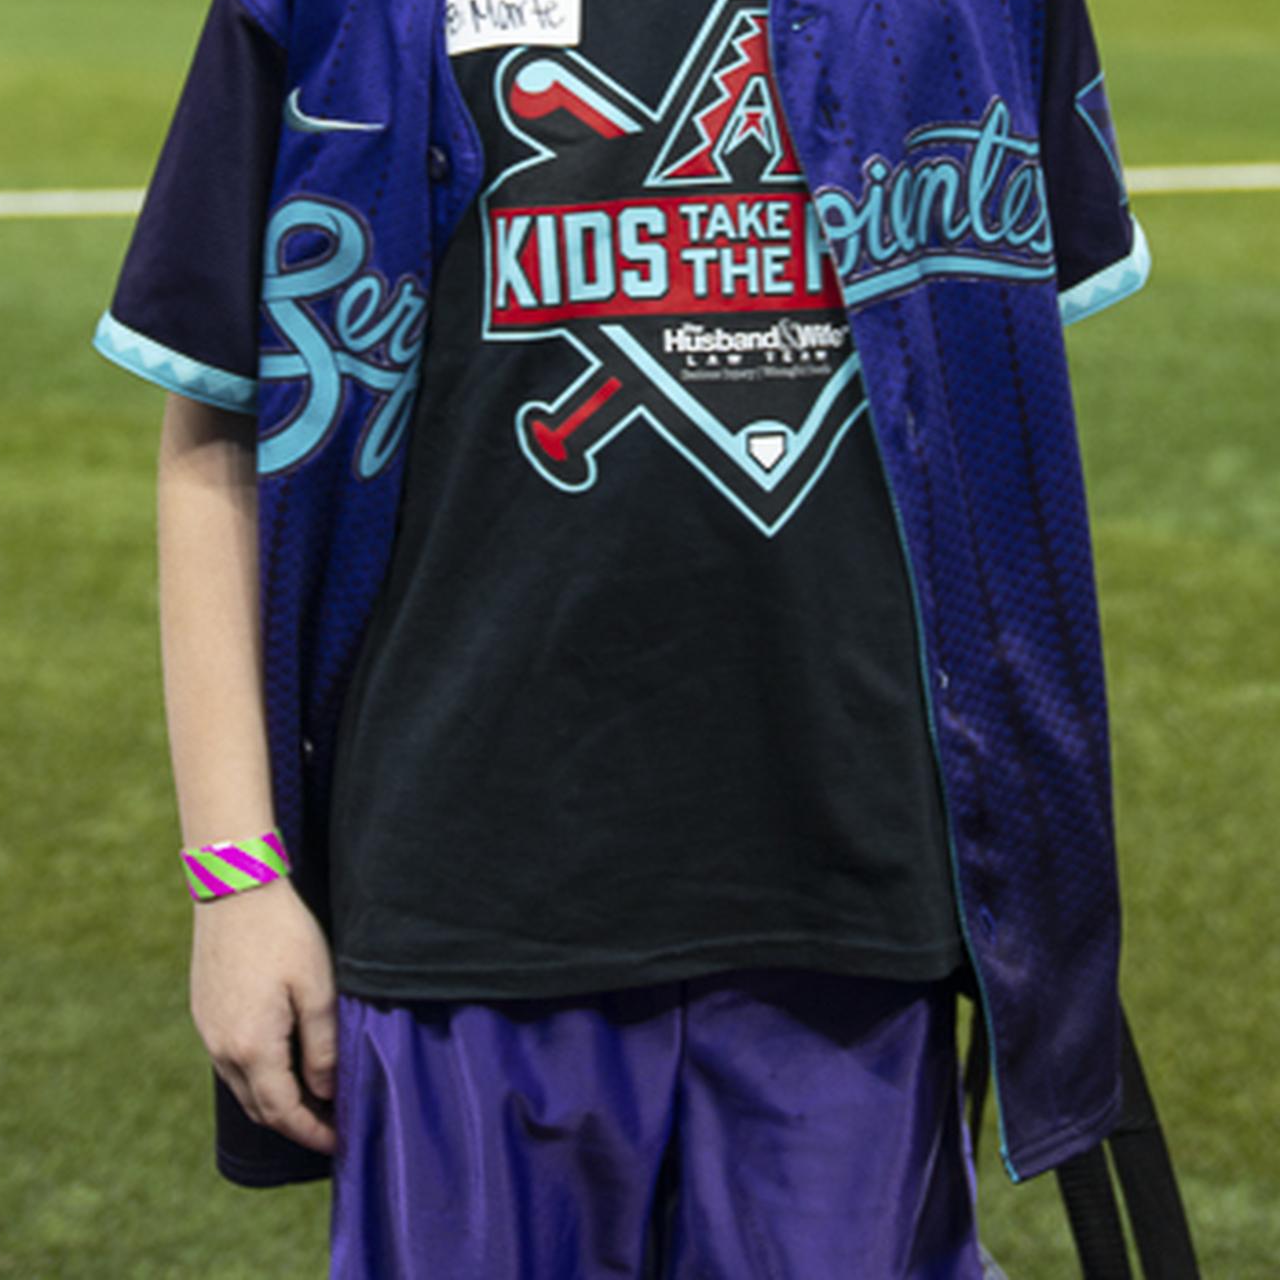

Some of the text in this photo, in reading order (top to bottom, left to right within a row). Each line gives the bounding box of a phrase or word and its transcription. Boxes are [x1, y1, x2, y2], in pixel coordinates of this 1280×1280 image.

[679, 201, 792, 242] TAKE
[495, 206, 668, 309] KIDS
[681, 246, 794, 297] THE
[664, 324, 780, 352] Husband
